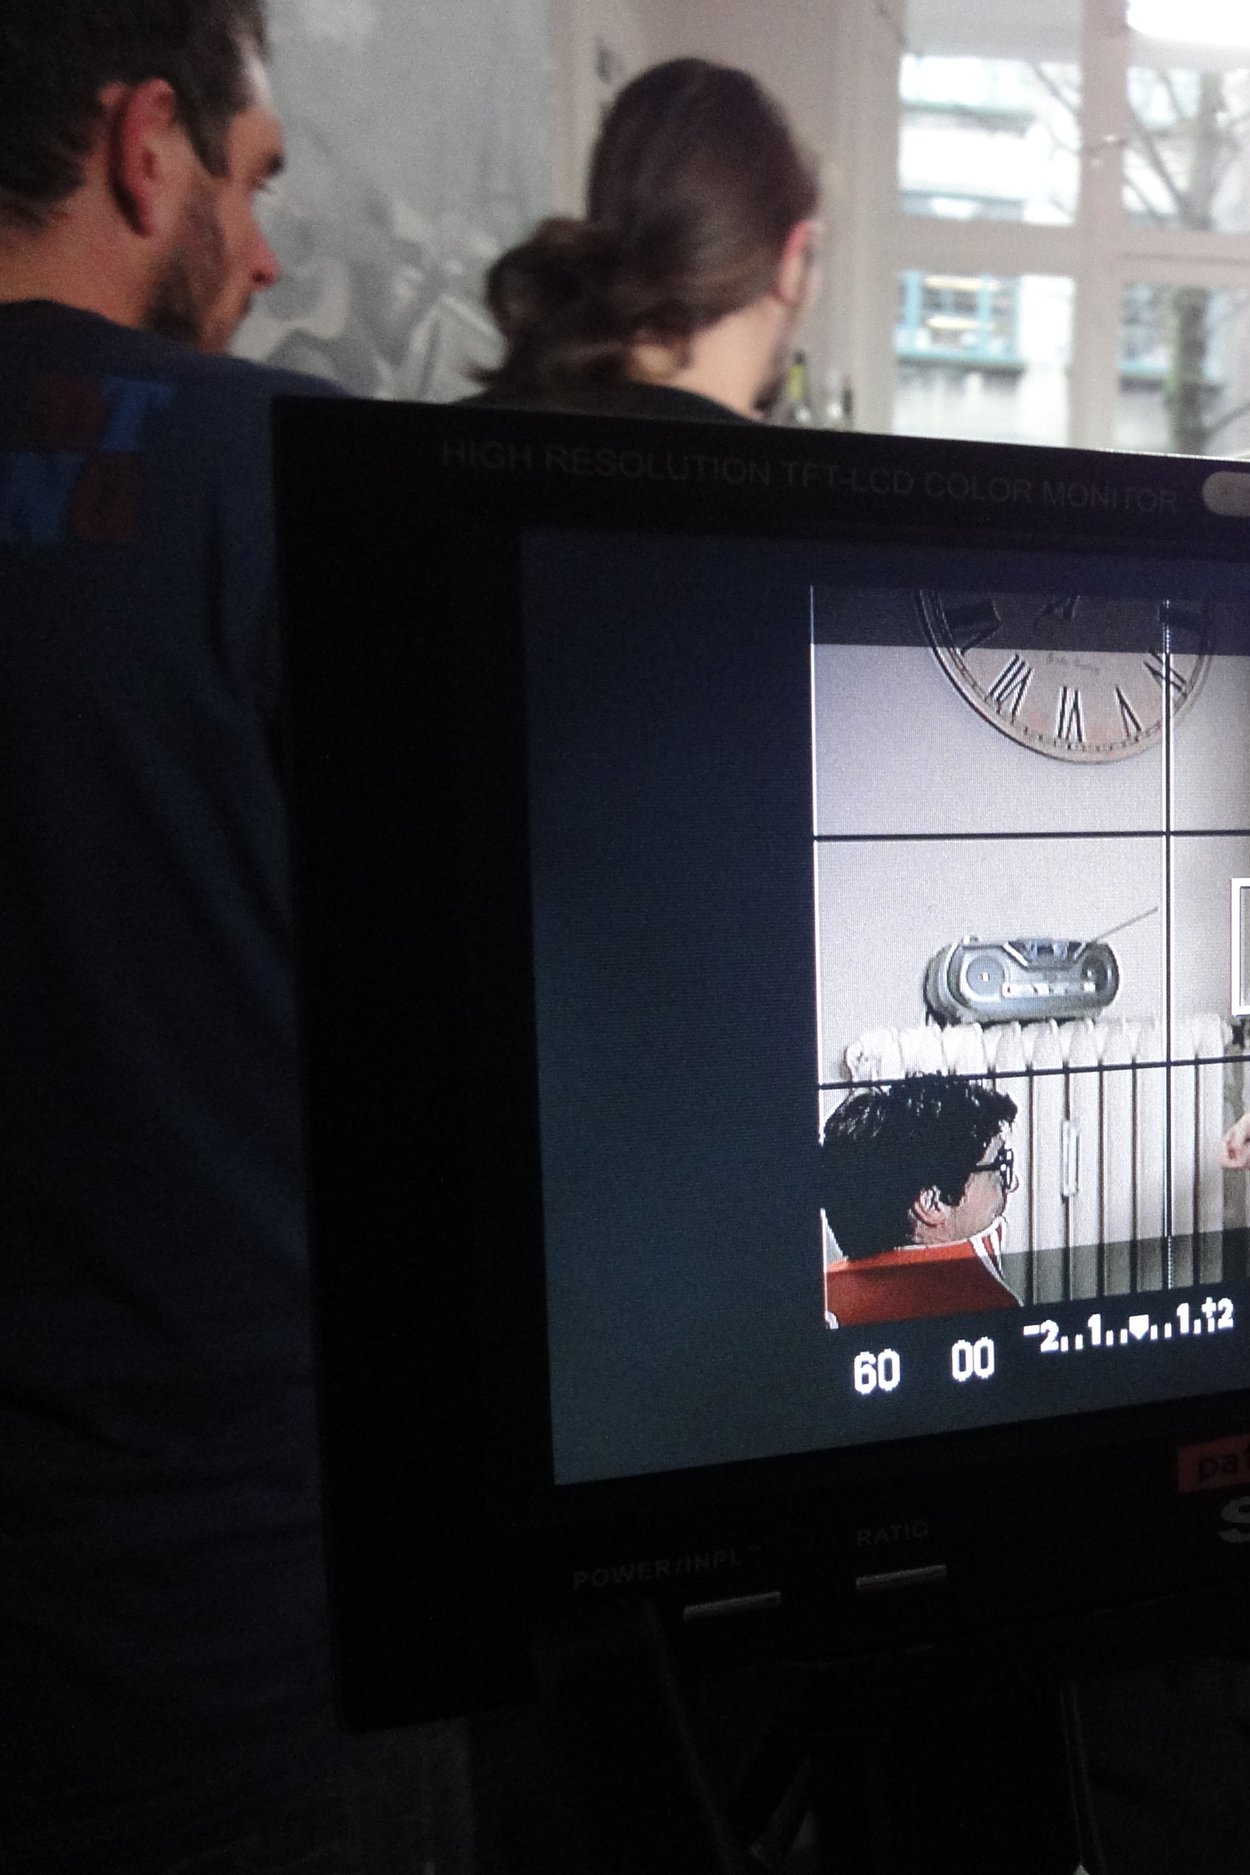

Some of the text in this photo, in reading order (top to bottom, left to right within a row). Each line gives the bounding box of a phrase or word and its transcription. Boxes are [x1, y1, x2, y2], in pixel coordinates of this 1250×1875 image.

[441, 439, 1179, 514] HIGH RESOLUTION TFT-LCD COLOR MONITOR
[853, 1347, 901, 1395] 60
[951, 1336, 996, 1382] 00
[855, 1519, 930, 1546] RATIO
[572, 1545, 762, 1592] POWER/INP
